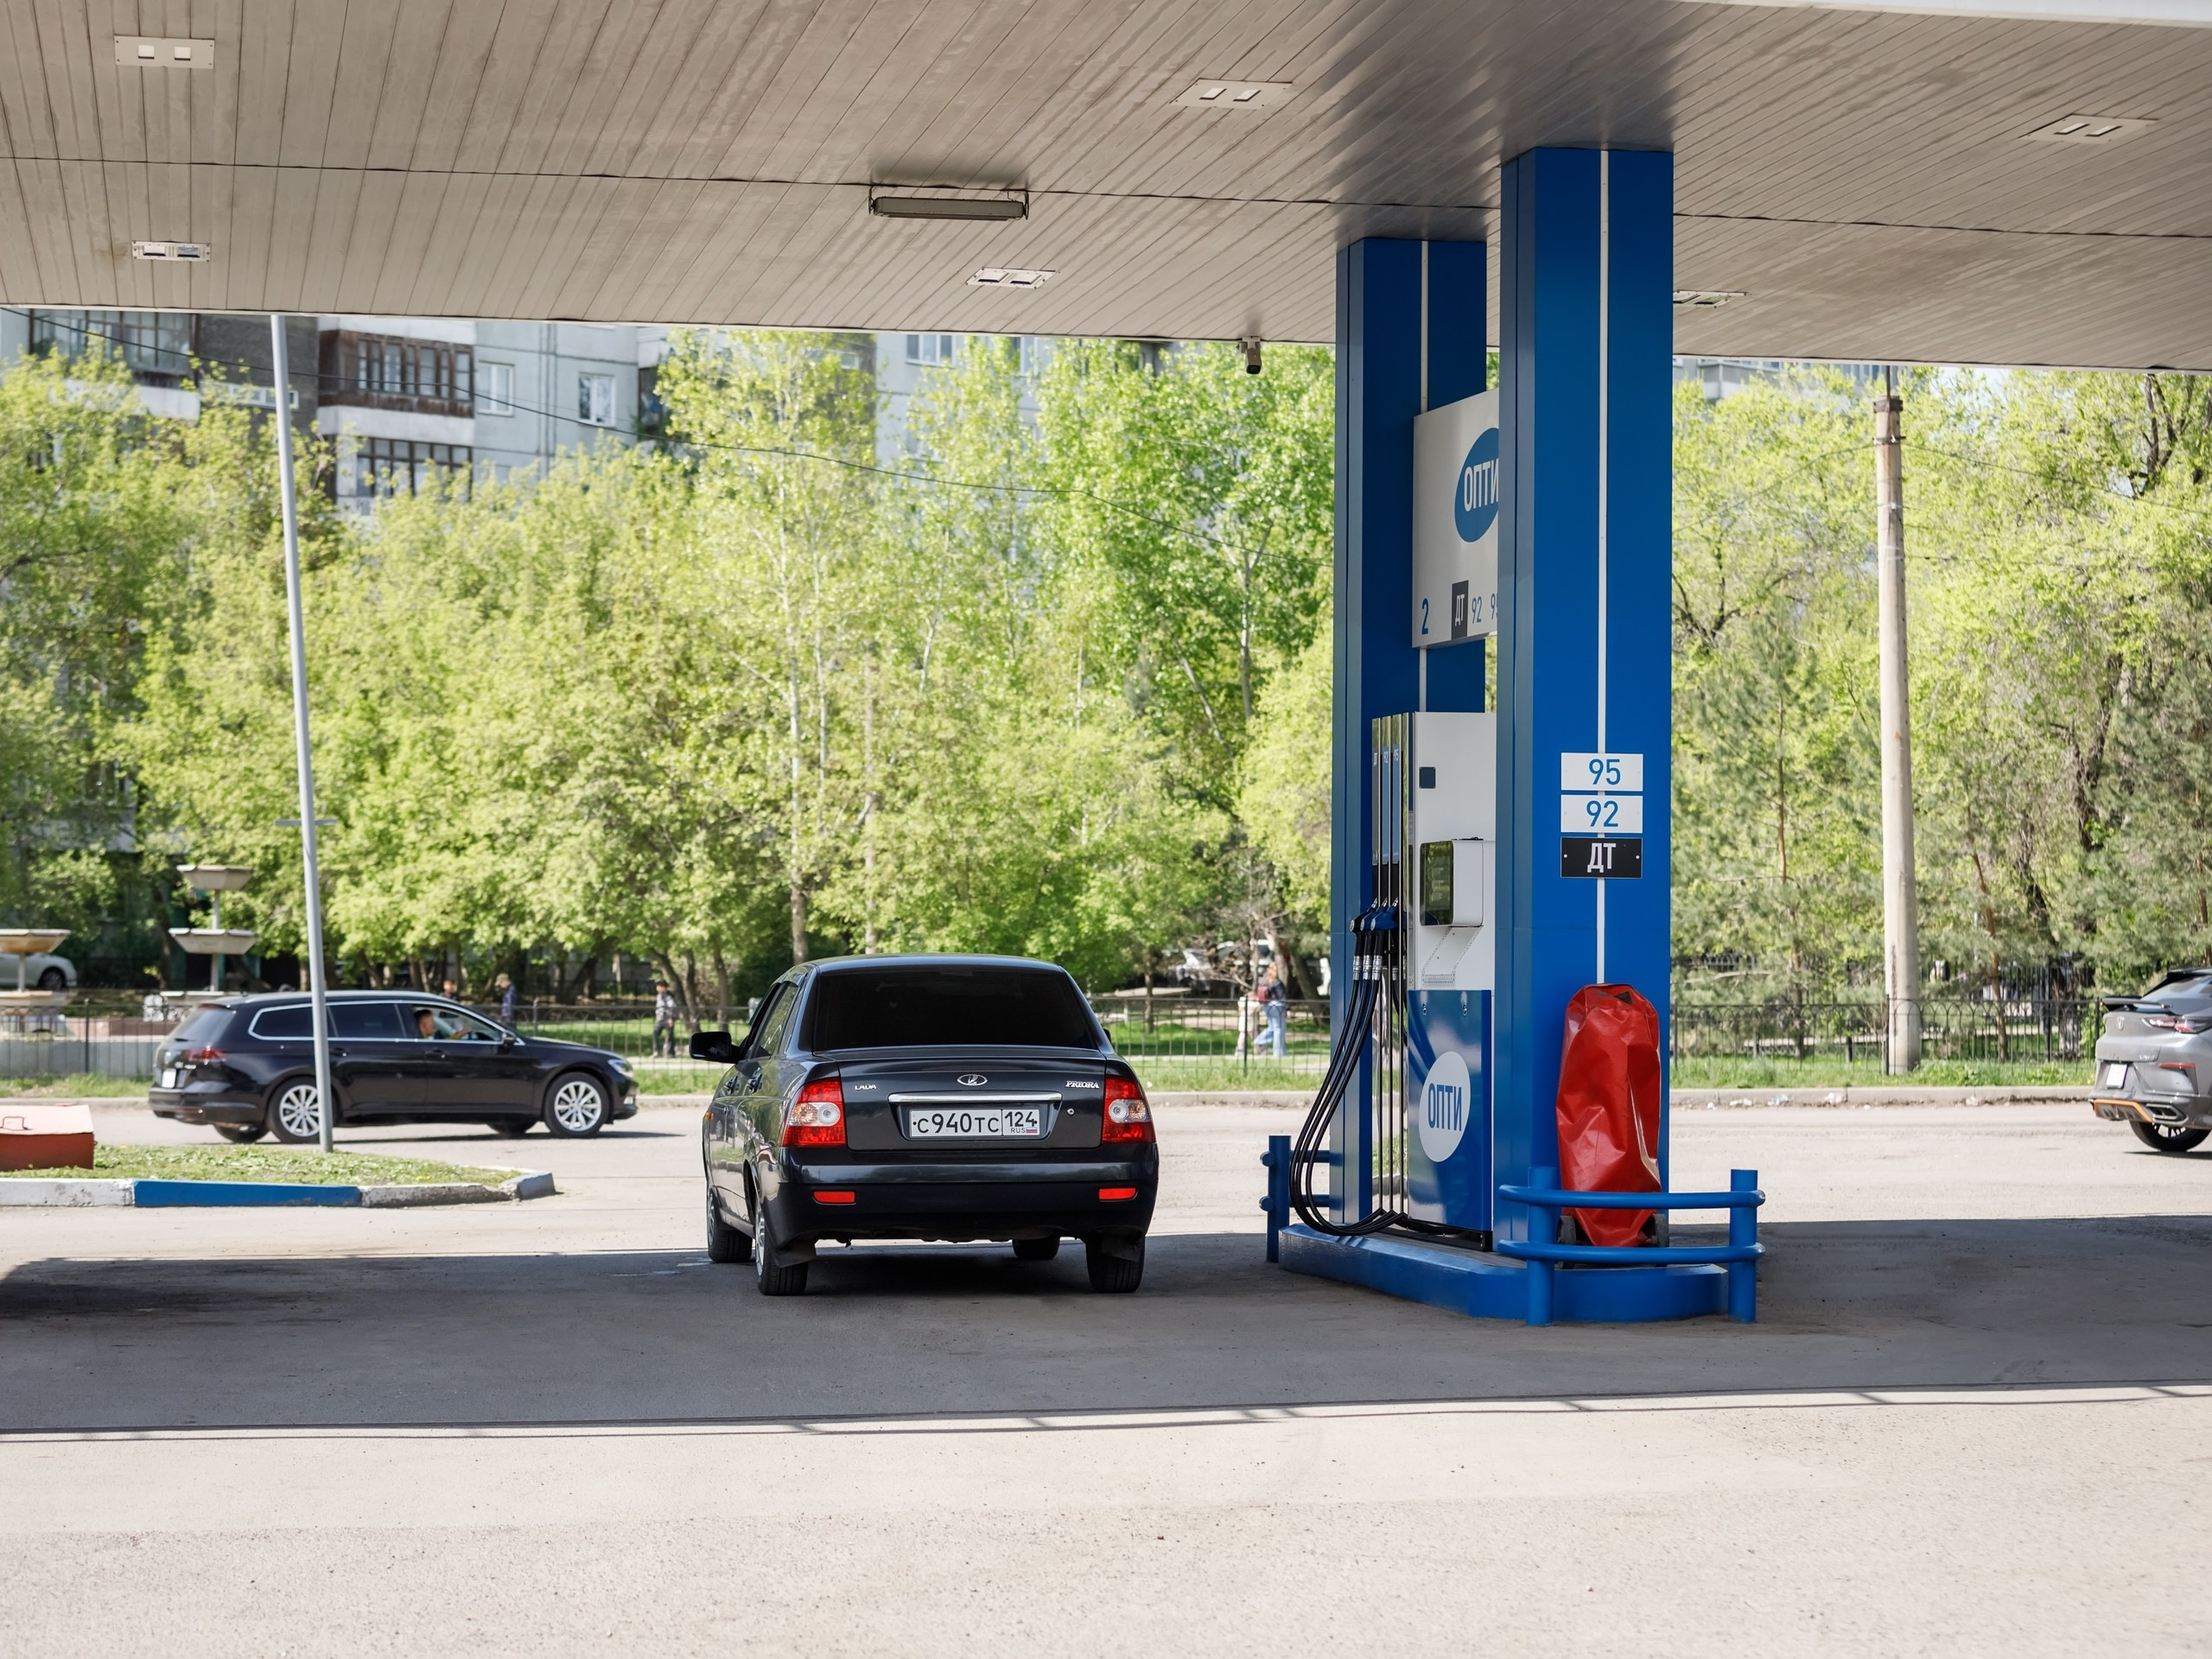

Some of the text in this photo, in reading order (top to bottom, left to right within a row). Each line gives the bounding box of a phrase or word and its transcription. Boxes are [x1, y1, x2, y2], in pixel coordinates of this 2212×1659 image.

[1464, 458, 1499, 512] ОПТИ
[1421, 593, 1497, 635] 2 ДТ 92 9
[1588, 759, 1621, 785] 95
[1586, 800, 1618, 827] 92
[1586, 842, 1617, 874] ДТ
[1065, 1080, 1100, 1089] PRIORA
[1427, 1083, 1462, 1131] ОПТИ
[917, 1111, 1035, 1134] С940ТС 124
